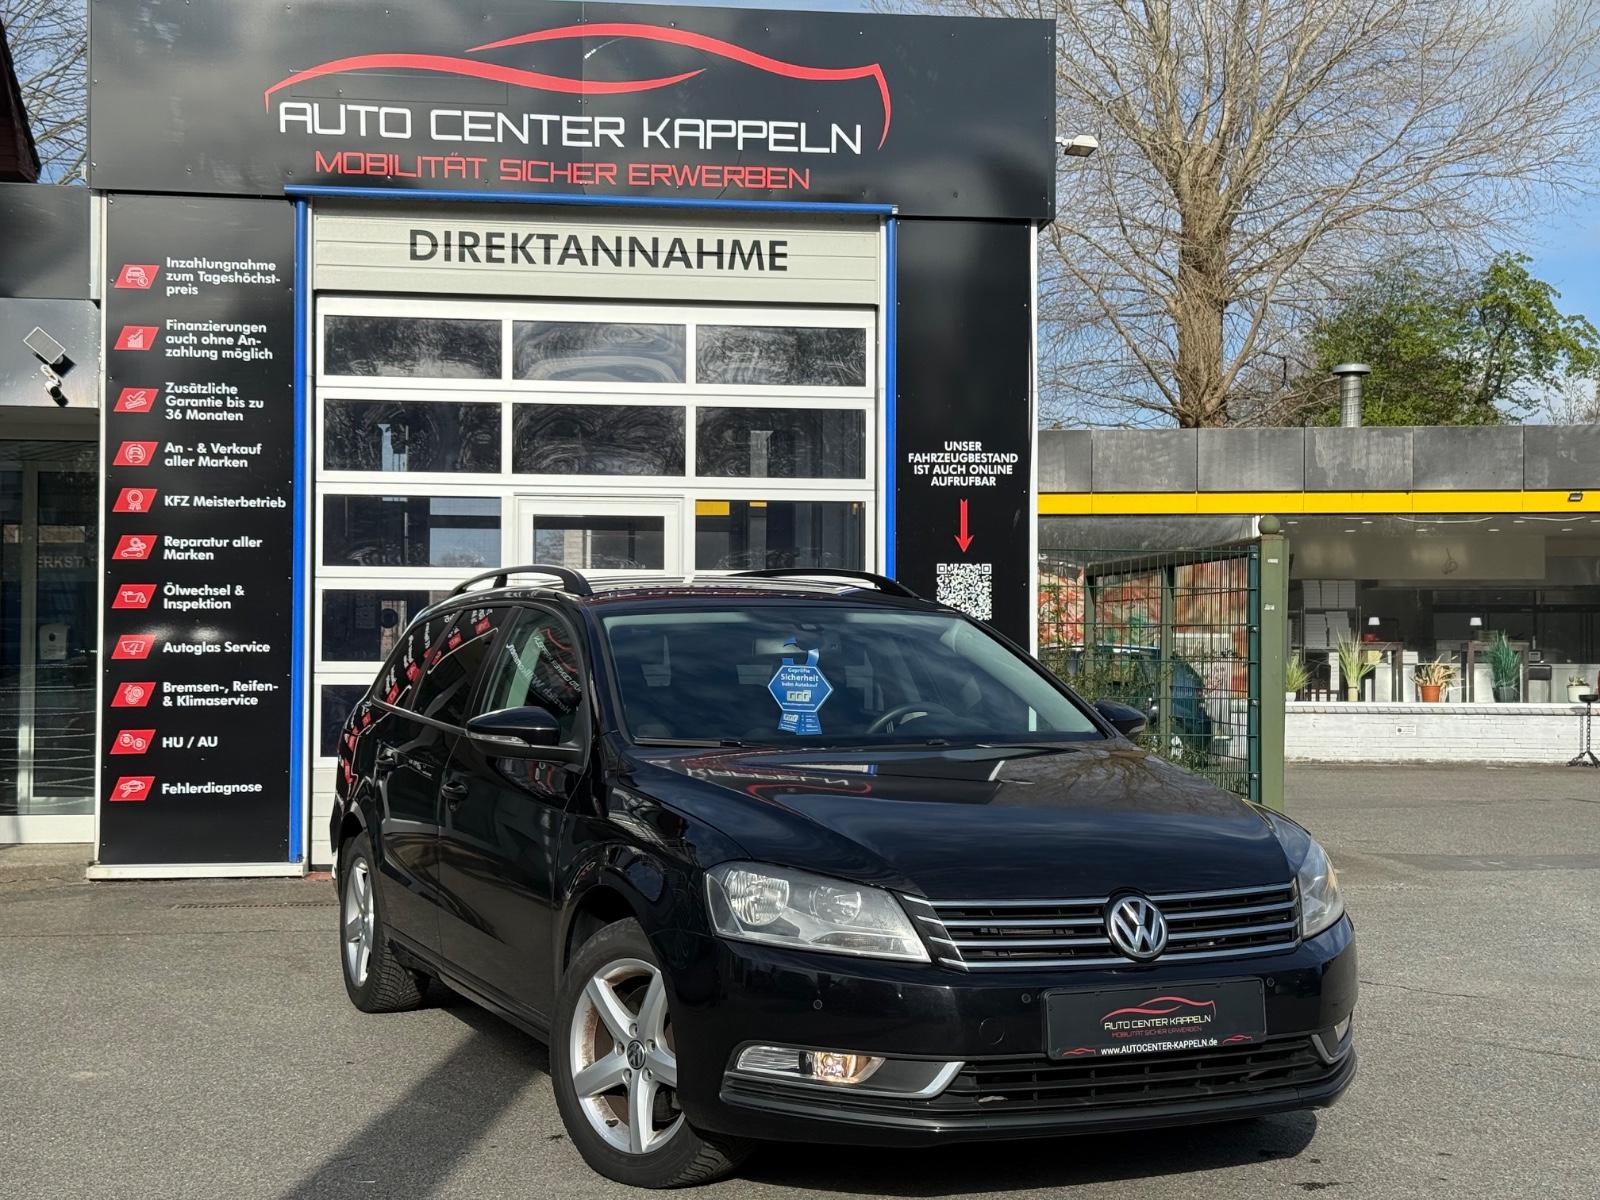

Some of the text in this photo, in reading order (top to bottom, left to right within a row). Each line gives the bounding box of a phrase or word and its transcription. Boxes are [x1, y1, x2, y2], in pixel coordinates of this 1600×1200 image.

[279, 102, 861, 154] AUTO CENTER KAPPELN
[315, 151, 809, 189] MOBILITÄT SICHER ERWERBEN
[410, 229, 788, 271] DIREKTANNAHME
[166, 257, 276, 272] Inzahlungnahme
[166, 272, 280, 285] zum Tageshöchst-
[166, 284, 198, 297] preis
[166, 319, 267, 334] Finanzierungen
[166, 334, 261, 345] auch ohne An-
[165, 347, 273, 361] zahlung möglich
[165, 382, 237, 394] Zusätzliche
[165, 396, 264, 409] Garantie bis zu
[165, 410, 243, 421] 36 Monaten
[164, 443, 183, 453] An
[197, 444, 207, 454] &
[211, 443, 262, 455] Verkauf
[944, 441, 982, 451] UNSER
[164, 457, 248, 468] aller Marken
[908, 453, 1018, 463] FAHRZEUGBESTAND
[914, 465, 1012, 474] IST AUCH ONLINE
[931, 477, 996, 486] AUFRUFBAR
[164, 496, 286, 508] KFZ Meisterbetrieb
[164, 536, 262, 549] Reparatur aller
[163, 549, 214, 560] Marken
[163, 582, 245, 596] Ölwechsel &
[163, 599, 231, 611] Inspektion
[163, 642, 270, 655] Autoglas Service
[163, 681, 279, 694] Bremsen-, Reifen-
[162, 696, 258, 706] & Klimaservice
[162, 736, 218, 748] HU / AU
[162, 782, 262, 795] Fehlerdiagnose
[1104, 1014, 1211, 1030] AUTO CENTER KAPPELN
[1101, 1038, 1218, 1055] www.AUTOCENTER-KAPPELN.de
